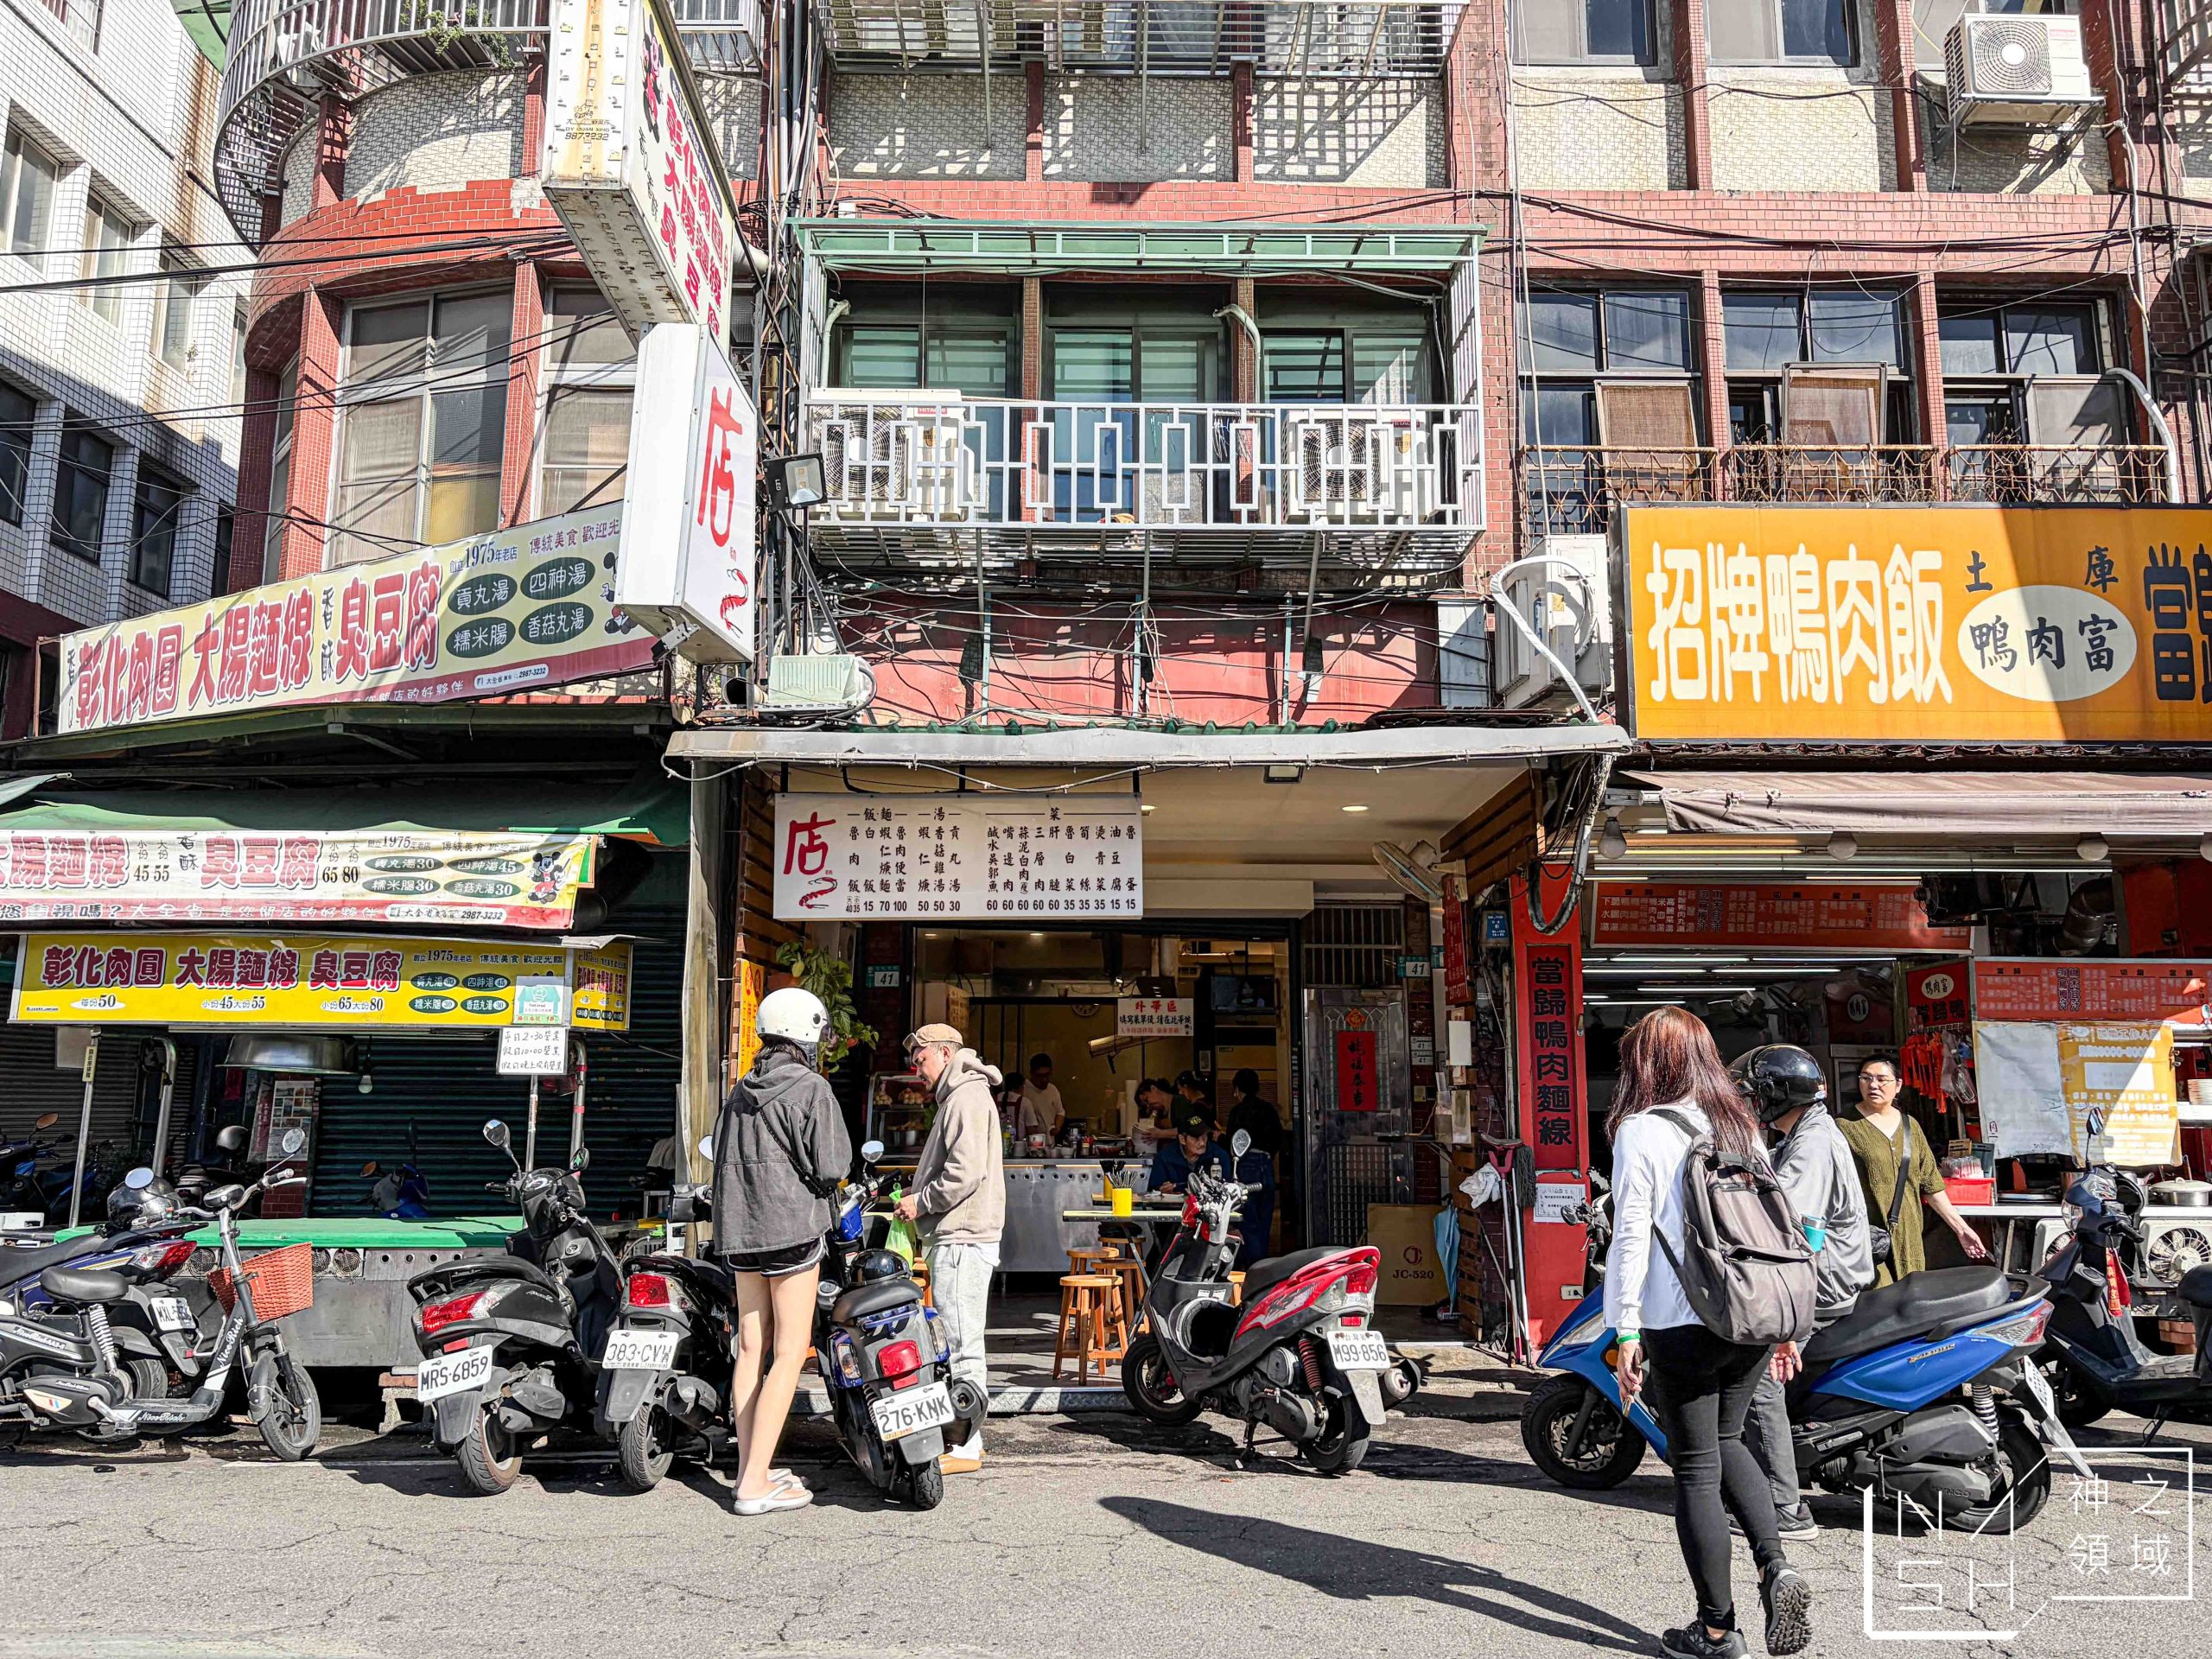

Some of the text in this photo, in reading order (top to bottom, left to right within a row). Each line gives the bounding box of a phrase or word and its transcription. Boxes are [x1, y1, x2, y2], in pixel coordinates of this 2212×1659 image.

[697, 386, 743, 548] 店
[530, 528, 578, 555] 傳統美食
[456, 578, 510, 611] 貢丸湯
[530, 563, 588, 594] 四神湯
[334, 560, 442, 684] 臭豆腐
[454, 622, 508, 654] 糯米腸
[527, 607, 585, 638] 香菇丸湯
[1645, 540, 1954, 704] 招牌鴨肉飯
[75, 589, 316, 732] 彰化肉圓 大腸麵線
[1969, 613, 2118, 673] 鴨肉富
[933, 807, 945, 821] 湯
[1049, 807, 1061, 821] 菜
[137, 840, 149, 860] 小份
[157, 840, 168, 860] 大份
[783, 811, 836, 875] 店
[848, 826, 861, 893] 魯肉飯
[895, 826, 907, 893] 魯肉便當
[949, 826, 961, 893] 貢丸湯
[1002, 826, 1014, 892] 嘴邊肉
[1033, 826, 1045, 891] 三層肉
[1065, 826, 1076, 891] 魯白菜
[1109, 826, 1122, 891] 油豆腐
[1125, 826, 1138, 891] 魯蛋
[133, 865, 170, 882] 45 55
[200, 836, 323, 889] 臭豆腐
[322, 866, 359, 883] 65 80
[461, 910, 504, 920] 2987-3232
[864, 900, 874, 912] 15
[880, 900, 890, 912] 70
[893, 900, 906, 912] 100
[918, 900, 929, 912] 50
[934, 900, 944, 912] 50
[950, 900, 960, 912] 30
[987, 899, 998, 910] 60
[1002, 899, 1014, 910] 60
[1018, 899, 1029, 910] 60
[1033, 899, 1044, 910] 60
[1048, 899, 1059, 910] 60
[1064, 899, 1075, 910] 35
[1078, 899, 1090, 910] 35
[1094, 899, 1105, 910] 35
[1110, 899, 1120, 910] 15
[1126, 899, 1136, 910] 15
[41, 944, 404, 991] 彰化肉圓 大腸麵線 臭豆腐
[480, 954, 519, 964] 傳統美食
[1411, 963, 1425, 976] 41
[467, 977, 494, 988] 四神湯
[880, 973, 893, 985] 41
[1531, 956, 1572, 1147] 當歸鴨肉麵線
[1392, 1270, 1434, 1280] JC-520
[420, 1355, 489, 1392] MRS-6859
